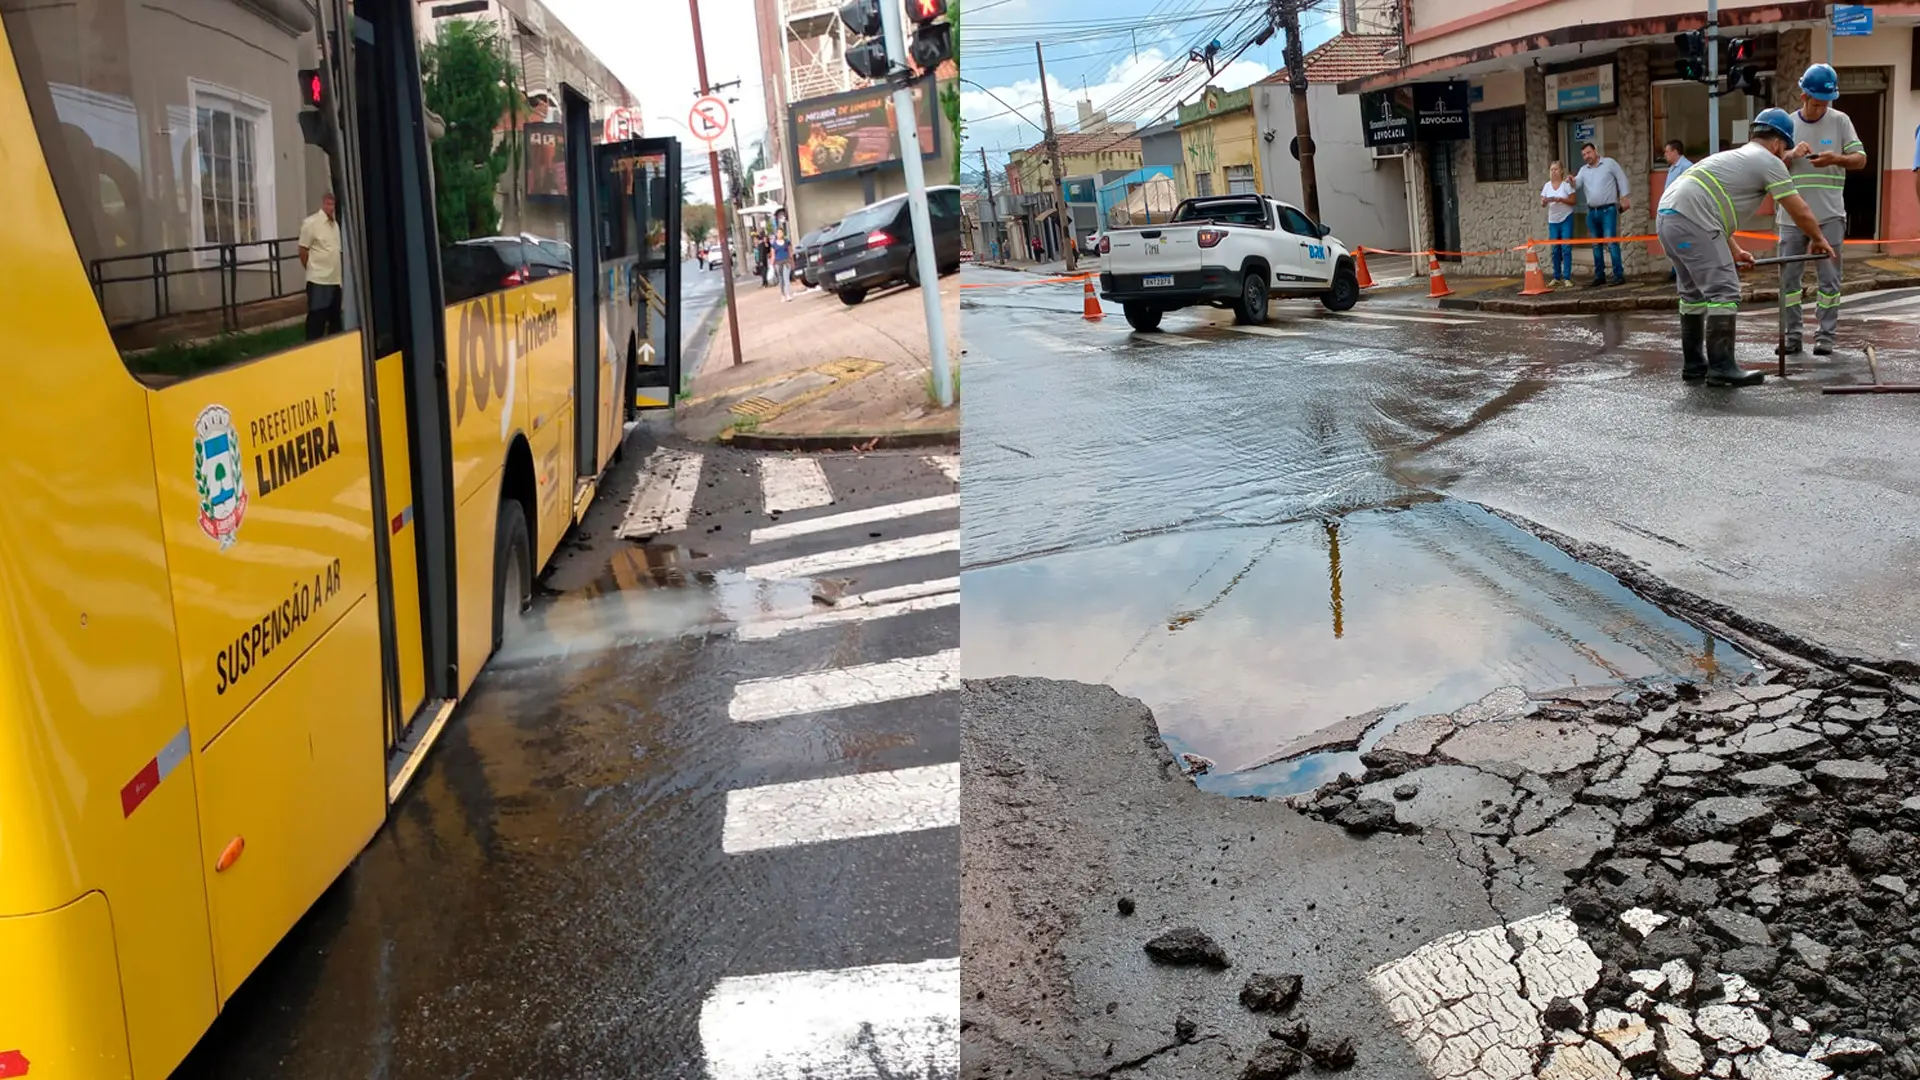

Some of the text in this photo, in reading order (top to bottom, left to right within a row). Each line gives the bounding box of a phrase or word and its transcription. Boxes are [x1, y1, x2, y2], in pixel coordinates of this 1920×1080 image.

[1373, 128, 1406, 140] ADVOCACIA
[1420, 116, 1463, 125] ADVOCACIA
[1308, 245, 1326, 259] BRK
[515, 303, 558, 359] Limeira
[250, 389, 337, 448] PREFEITURA DE
[254, 419, 341, 498] LIMEIRA
[216, 557, 341, 696] SUSPENSÃO A AR
